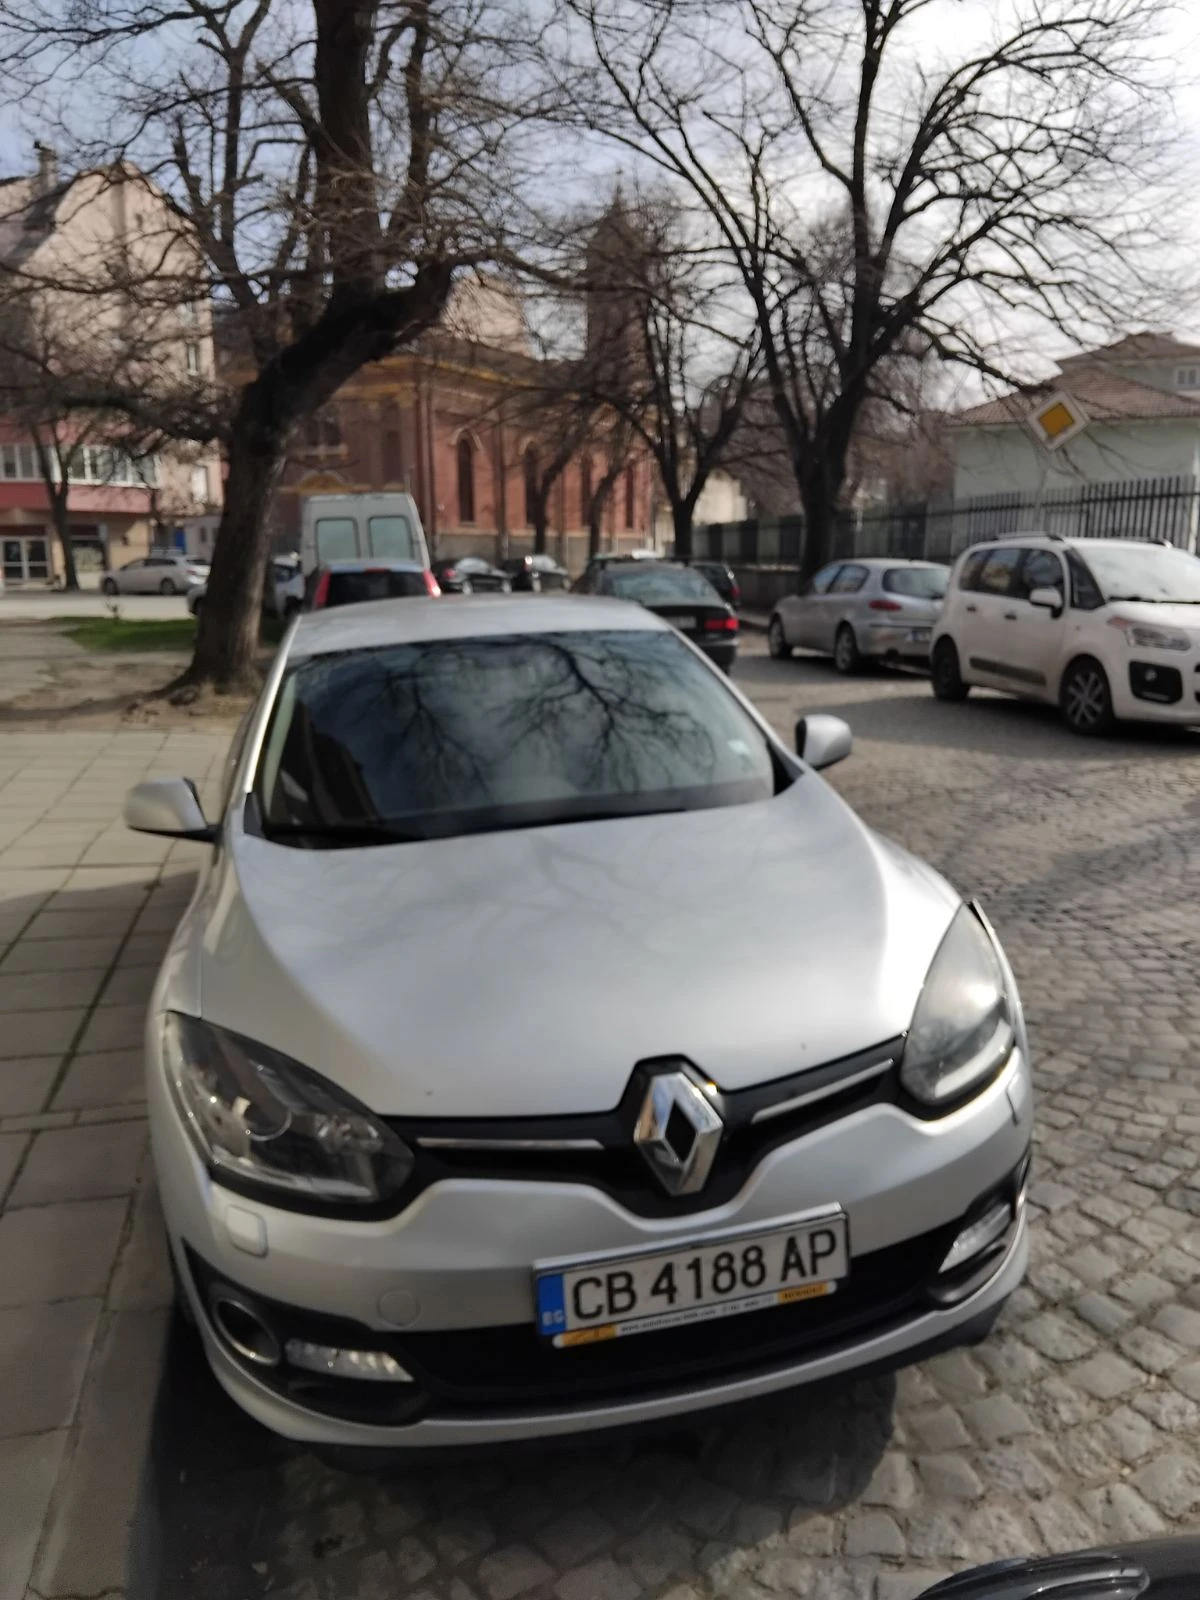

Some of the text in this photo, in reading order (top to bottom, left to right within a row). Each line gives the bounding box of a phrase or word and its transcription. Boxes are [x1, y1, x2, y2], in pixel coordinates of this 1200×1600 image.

[572, 1271, 637, 1320] CB
[650, 1245, 767, 1305] 4188
[780, 1228, 837, 1283] AP
